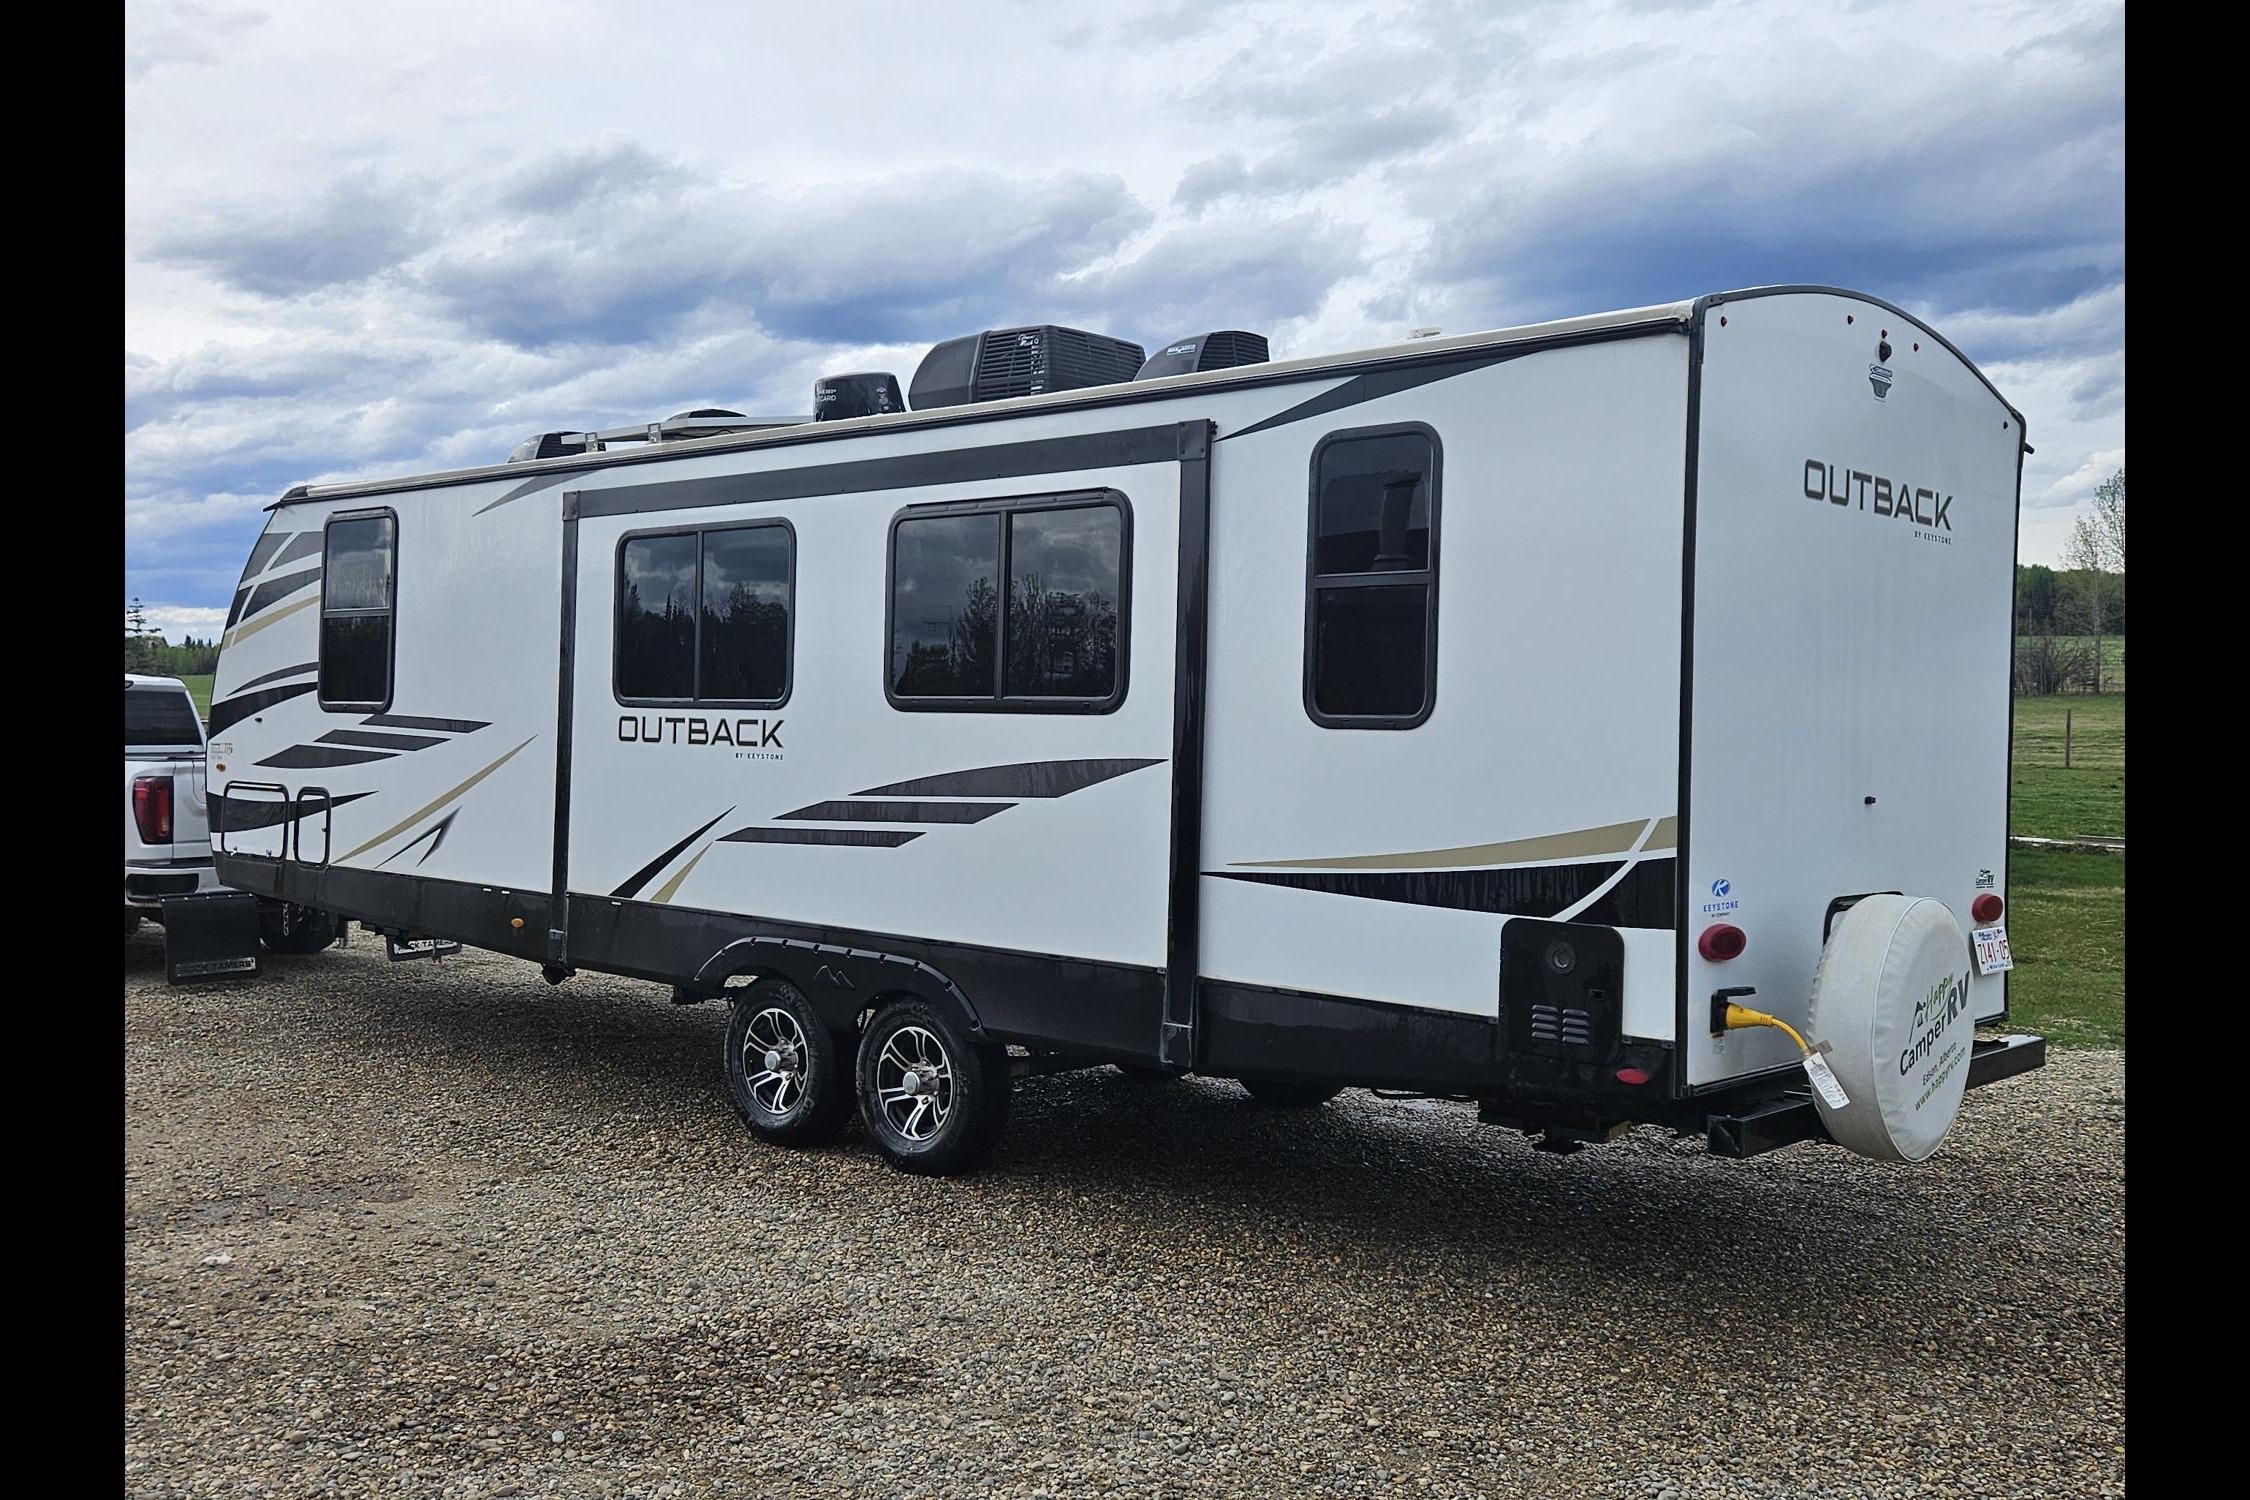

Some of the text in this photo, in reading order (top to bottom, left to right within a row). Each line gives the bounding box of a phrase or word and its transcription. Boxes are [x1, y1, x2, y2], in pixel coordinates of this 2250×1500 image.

[1804, 458, 1953, 531] OUTBACK
[1914, 530, 1952, 545] BY KEYSTONE
[619, 716, 785, 748] OUTBACK
[747, 753, 784, 761] KEYSTONE
[1703, 900, 1739, 912] KEYSTONE
